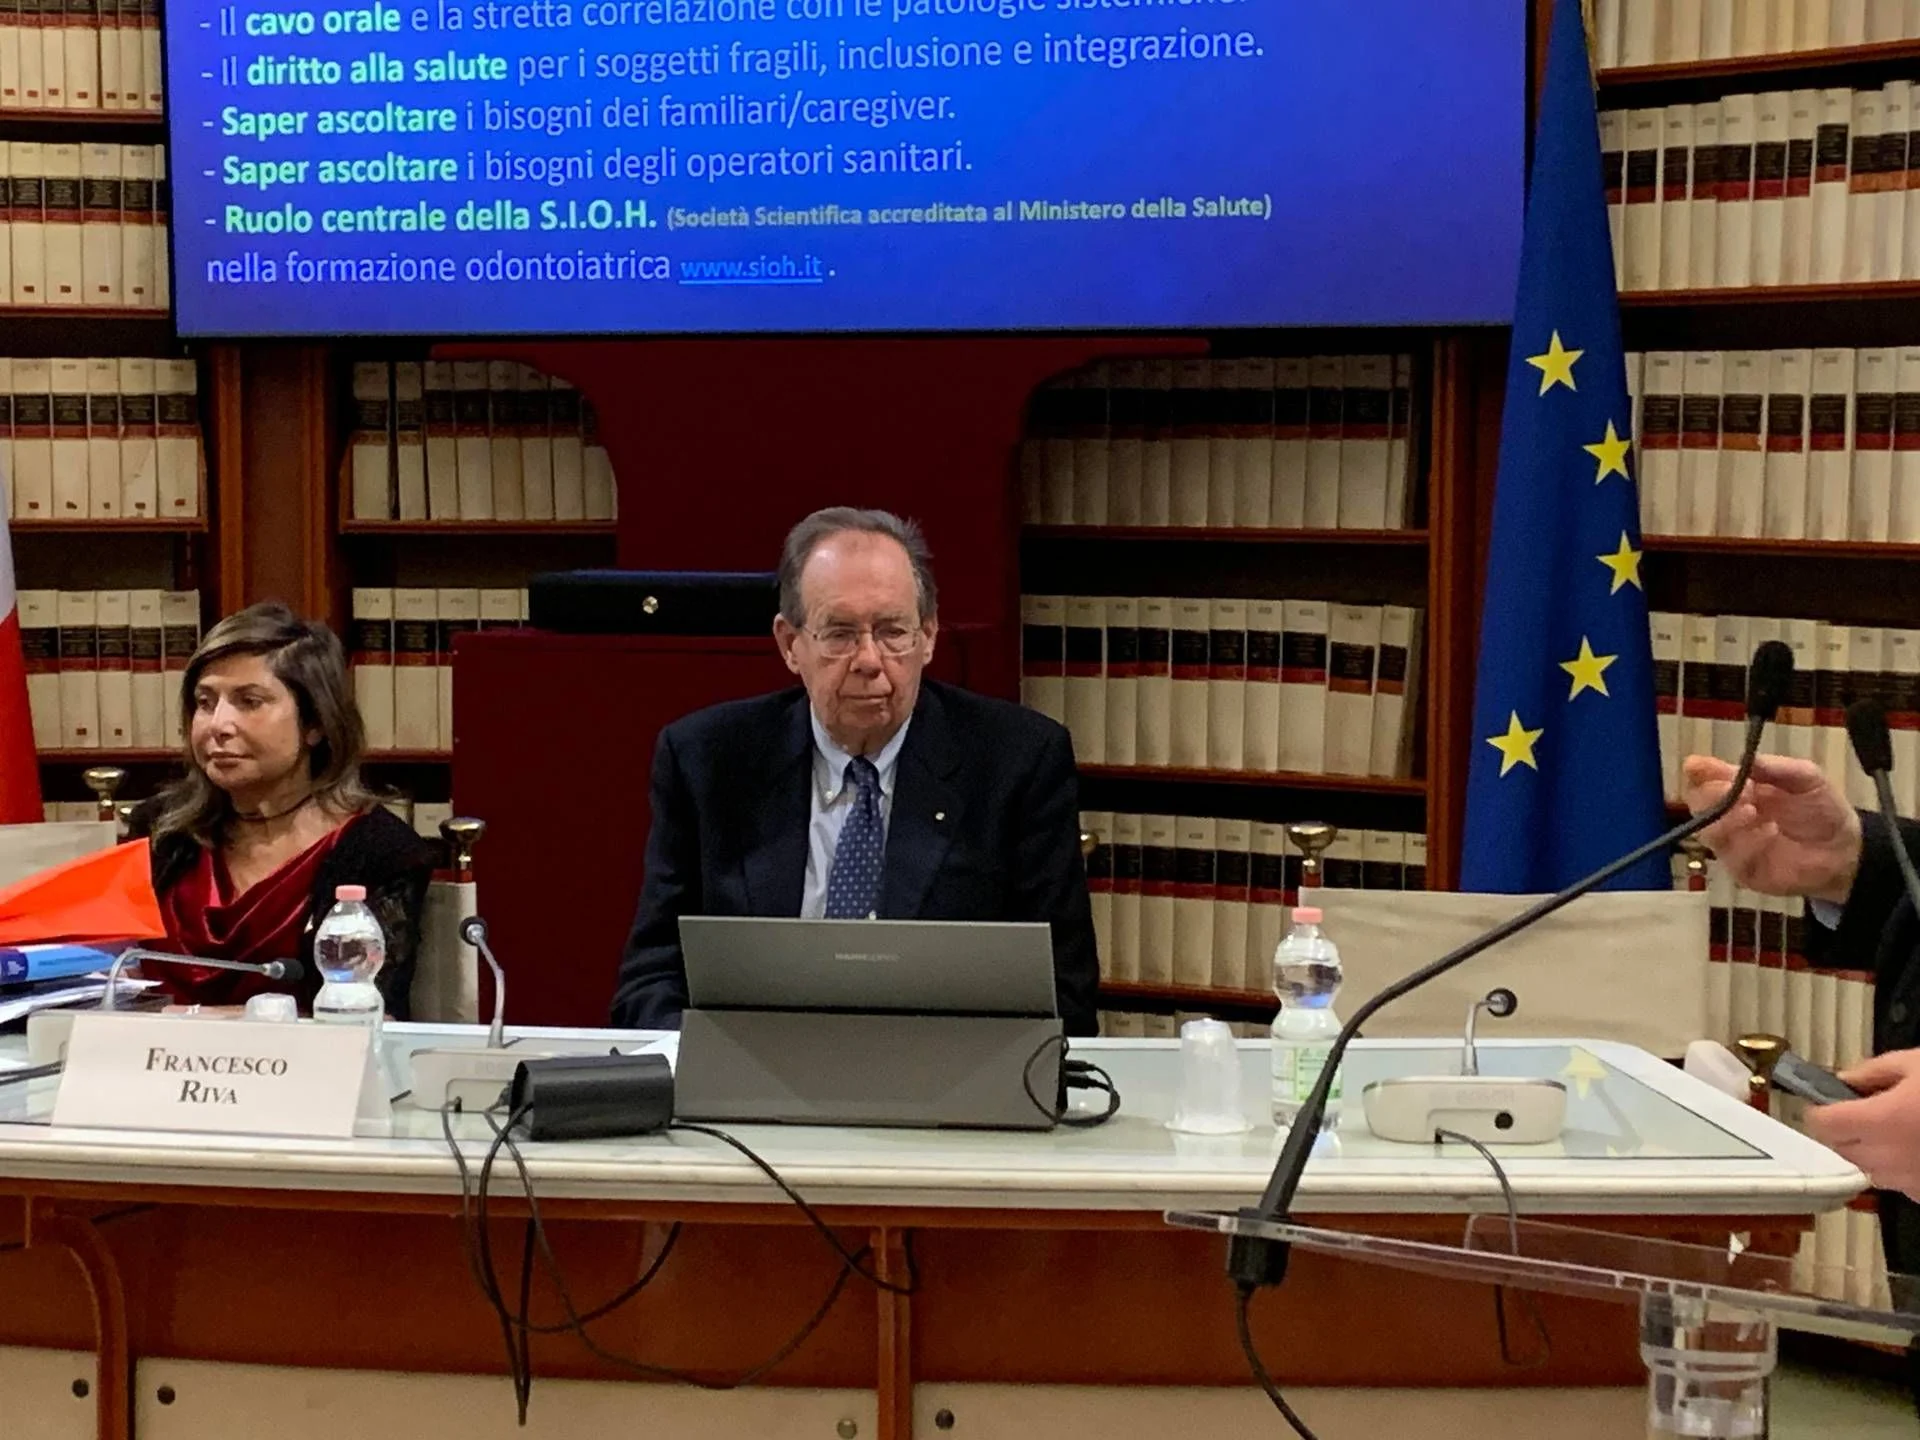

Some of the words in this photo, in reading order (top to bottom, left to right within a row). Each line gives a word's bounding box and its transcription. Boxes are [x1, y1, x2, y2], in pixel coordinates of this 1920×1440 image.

[220, 5, 237, 37] Il
[244, 11, 316, 37] cavo
[322, 0, 402, 35] orale
[411, 8, 429, 32] e
[438, 0, 463, 31] la
[472, 0, 572, 30] stretta
[582, 0, 776, 27] correlazione
[786, 0, 843, 20] con
[222, 55, 238, 87] Il
[246, 54, 342, 87] diritto
[349, 51, 405, 85] alla
[413, 49, 509, 83] salute
[519, 55, 570, 87] per
[578, 47, 586, 78] i
[595, 44, 720, 84] soggetti
[728, 39, 827, 80] fragili,
[838, 36, 1003, 70] inclusione
[1013, 40, 1033, 65] e
[1044, 26, 1264, 69] integrazione.
[221, 105, 310, 142] Saper
[316, 101, 458, 135] ascoltare
[466, 100, 474, 131] i
[483, 98, 593, 136] bisogni
[602, 96, 649, 128] dei
[658, 90, 956, 129] familiari/caregiver.
[222, 154, 311, 191] Saper
[317, 151, 459, 184] ascoltare
[467, 151, 475, 181] i
[485, 148, 594, 187] bisogni
[603, 145, 677, 185] degli
[686, 143, 833, 184] operatori
[843, 139, 973, 174] sanitari.
[224, 202, 314, 235] Ruolo
[320, 200, 448, 233] centrale
[455, 199, 531, 232] della
[539, 199, 658, 231] S.I.O.H.
[666, 205, 750, 232] (Società
[754, 203, 863, 227] Scientifica
[867, 201, 989, 225] accreditata
[992, 200, 1013, 222] al
[1019, 199, 1127, 222] Ministero
[1130, 196, 1187, 219] della
[1191, 193, 1273, 221] Salute)
[207, 251, 277, 283] nella
[285, 250, 457, 283] formazione
[465, 249, 670, 282] odontoiatrica
[678, 254, 824, 283] www.sioh.it
[146, 1047, 288, 1076] FRANCESCO
[178, 1079, 237, 1104] RIVA
